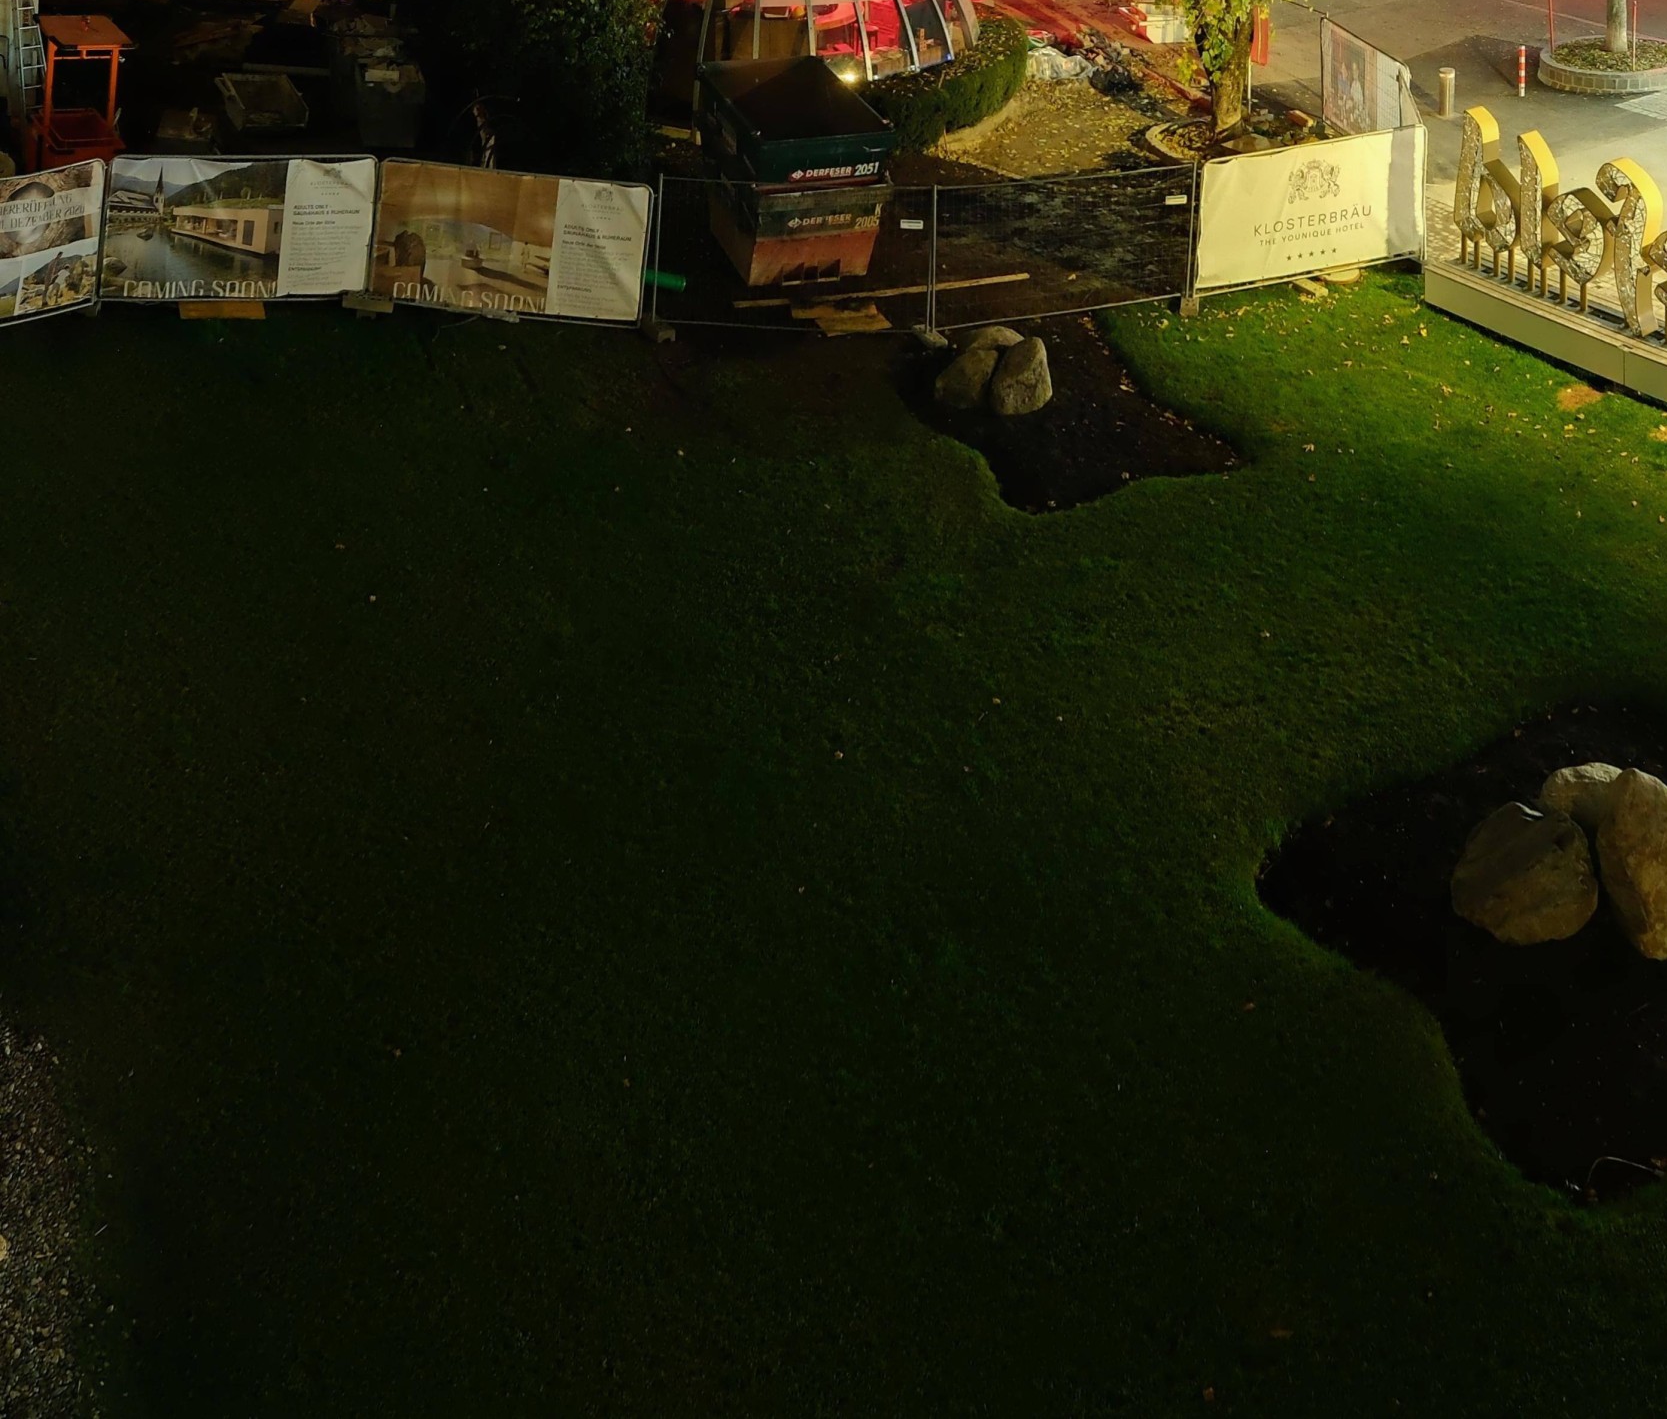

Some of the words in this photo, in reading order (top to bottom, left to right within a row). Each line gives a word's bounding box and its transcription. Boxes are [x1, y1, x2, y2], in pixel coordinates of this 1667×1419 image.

[805, 166, 852, 178] DERFESER
[854, 162, 879, 176] 2051
[802, 213, 852, 226] DERESER
[1253, 204, 1372, 237] KLOSTERBRÄU
[1259, 237, 1277, 246] THE
[1281, 228, 1331, 243] YOUNIQUE
[1336, 222, 1364, 234] HOTEL
